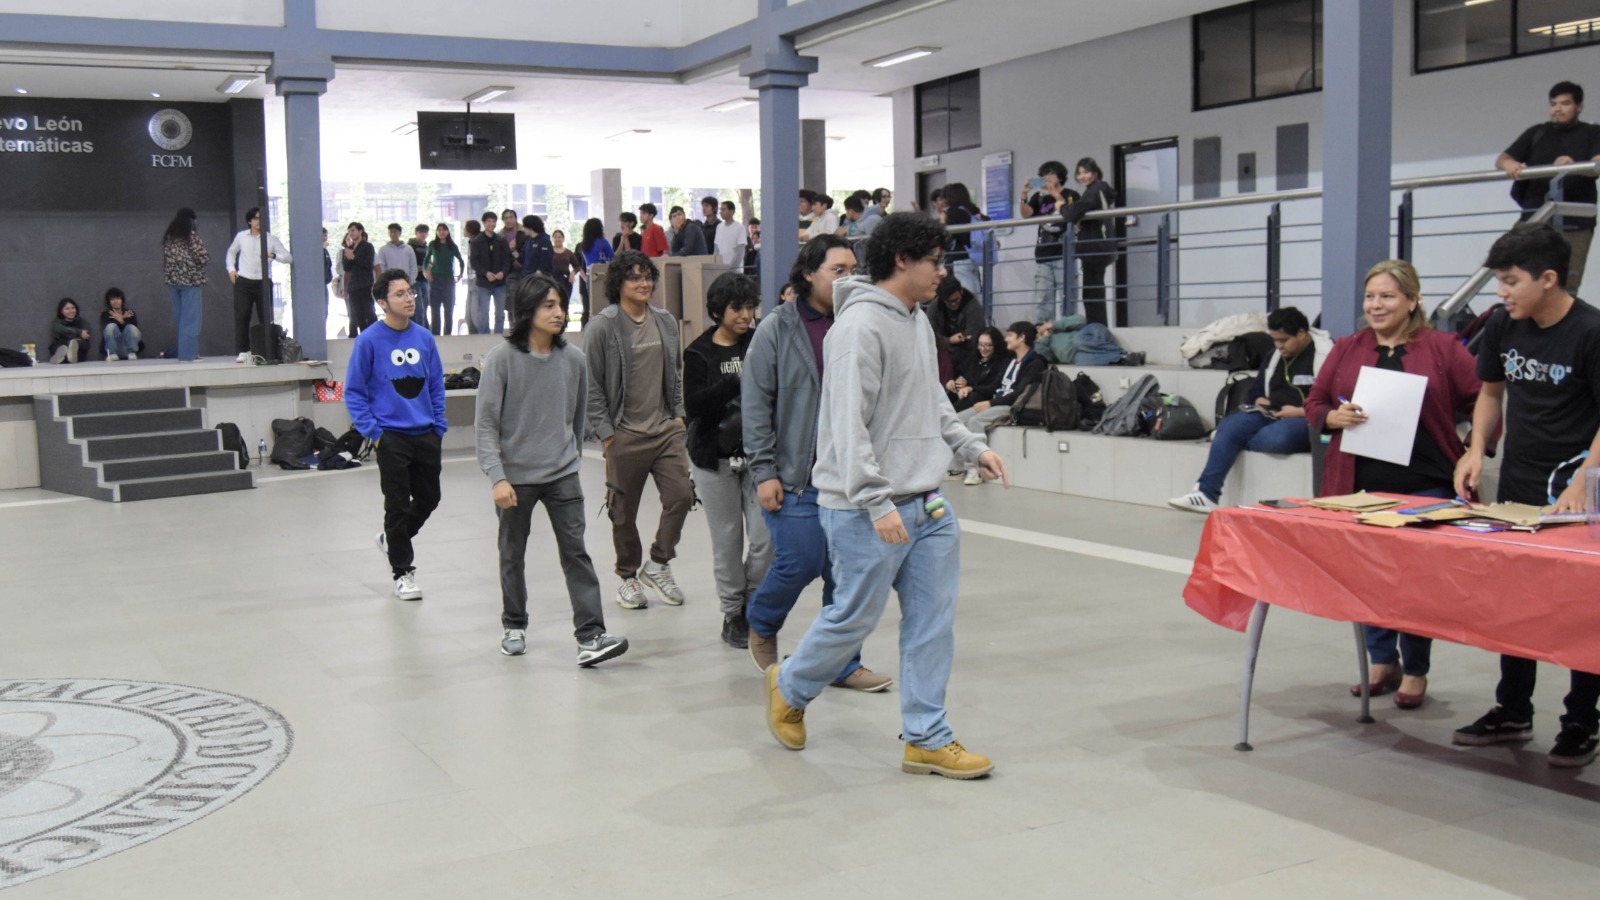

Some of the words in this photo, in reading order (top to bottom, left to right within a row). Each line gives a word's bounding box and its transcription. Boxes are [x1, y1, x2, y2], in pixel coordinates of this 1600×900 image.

[33, 115, 83, 131] León
[151, 154, 193, 168] FCFM
[1524, 358, 1538, 381] S
[1536, 362, 1549, 373] DE
[1535, 372, 1547, 382] LA
